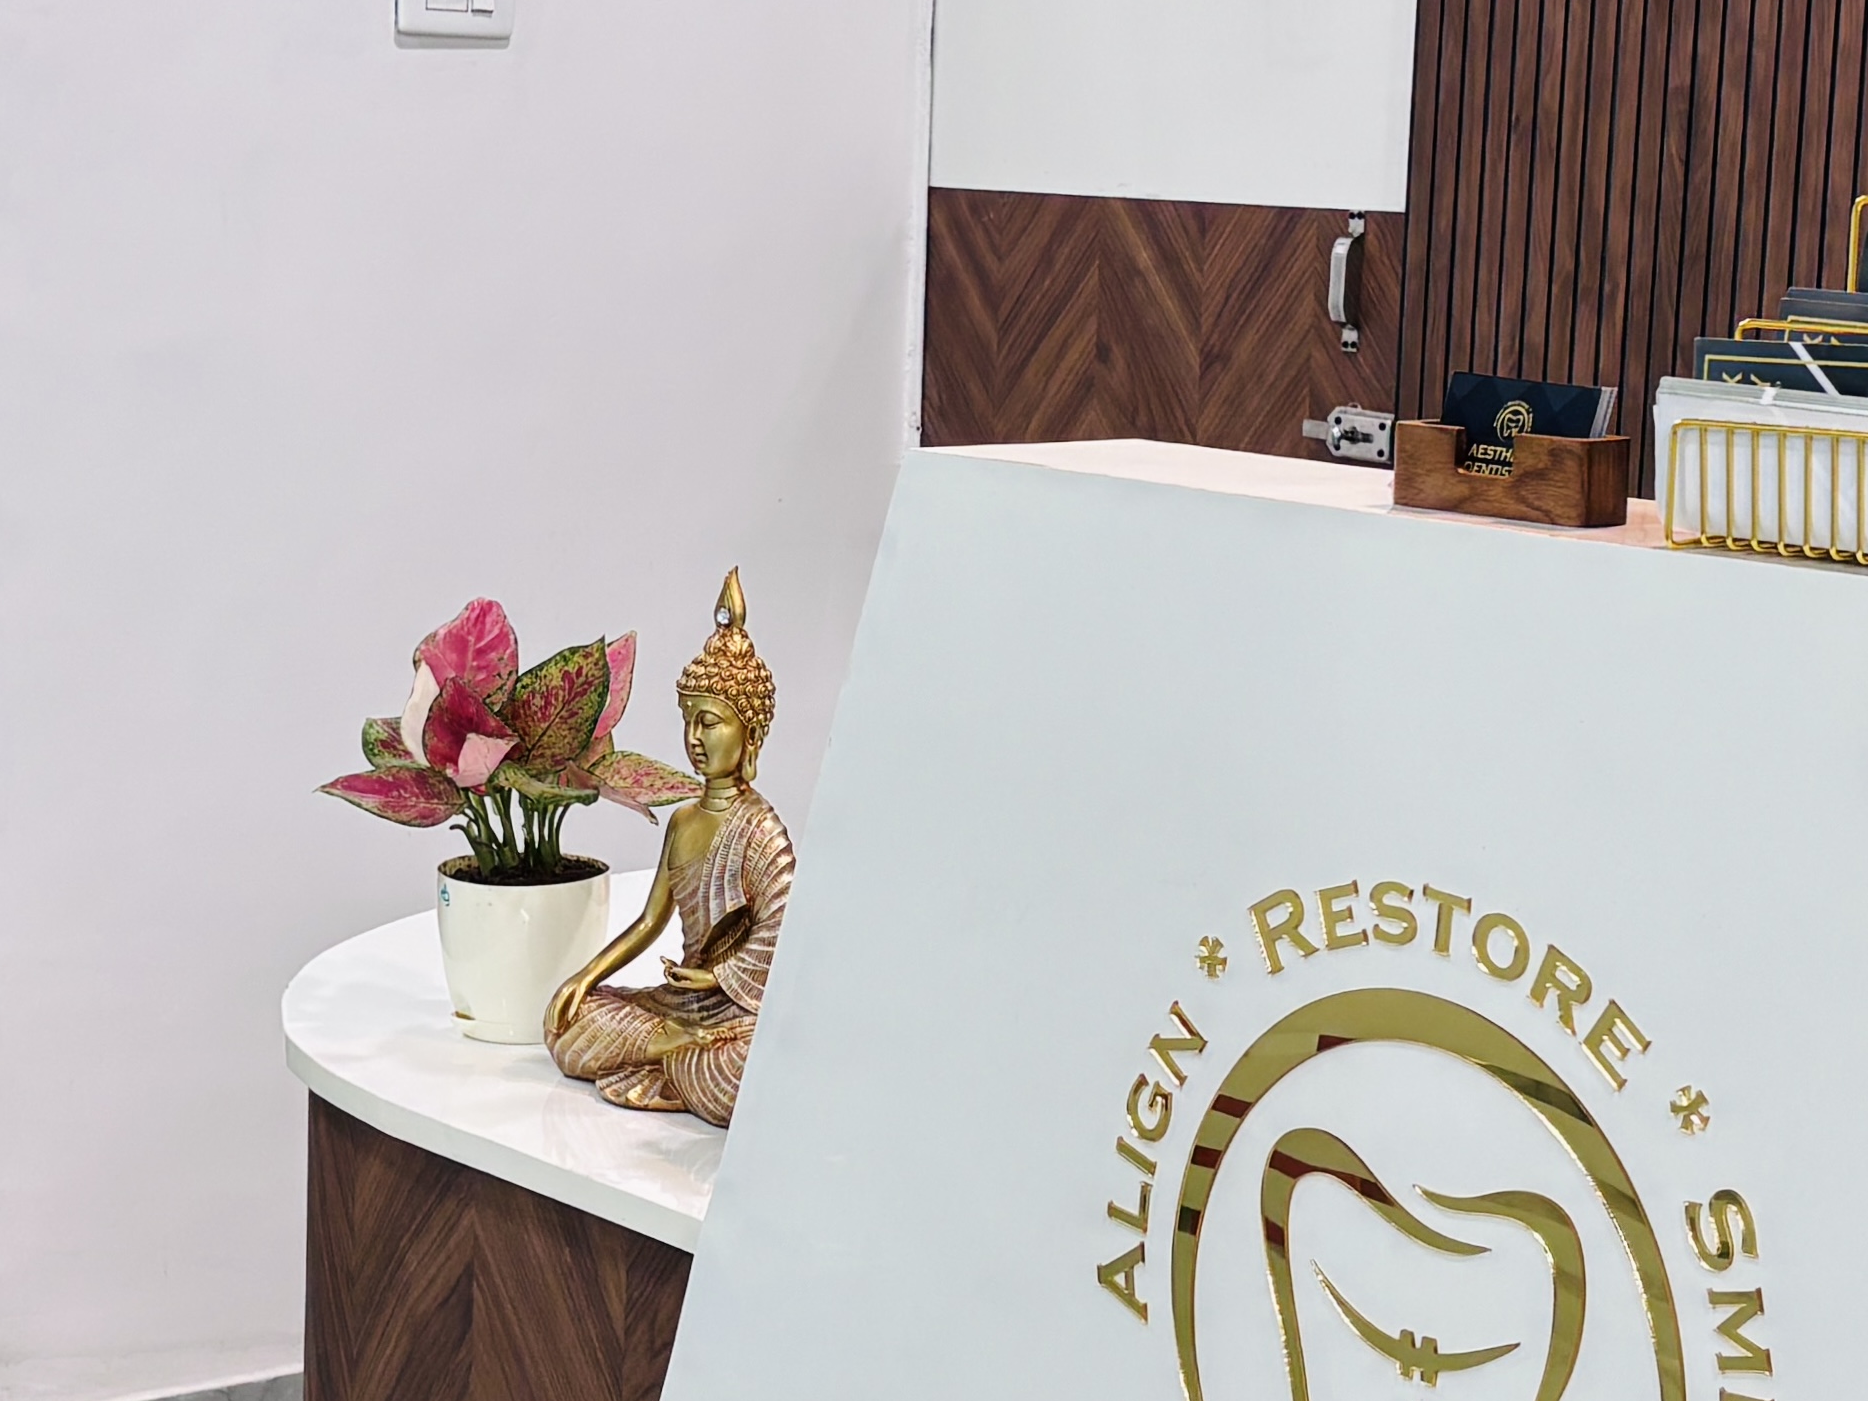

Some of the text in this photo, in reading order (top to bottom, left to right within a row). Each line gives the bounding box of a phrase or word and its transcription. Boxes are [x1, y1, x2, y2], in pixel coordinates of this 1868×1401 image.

[1467, 443, 1514, 462] AESTH
[1096, 999, 1209, 1326] ALIGN
[1247, 878, 1653, 1094] RESTORE
